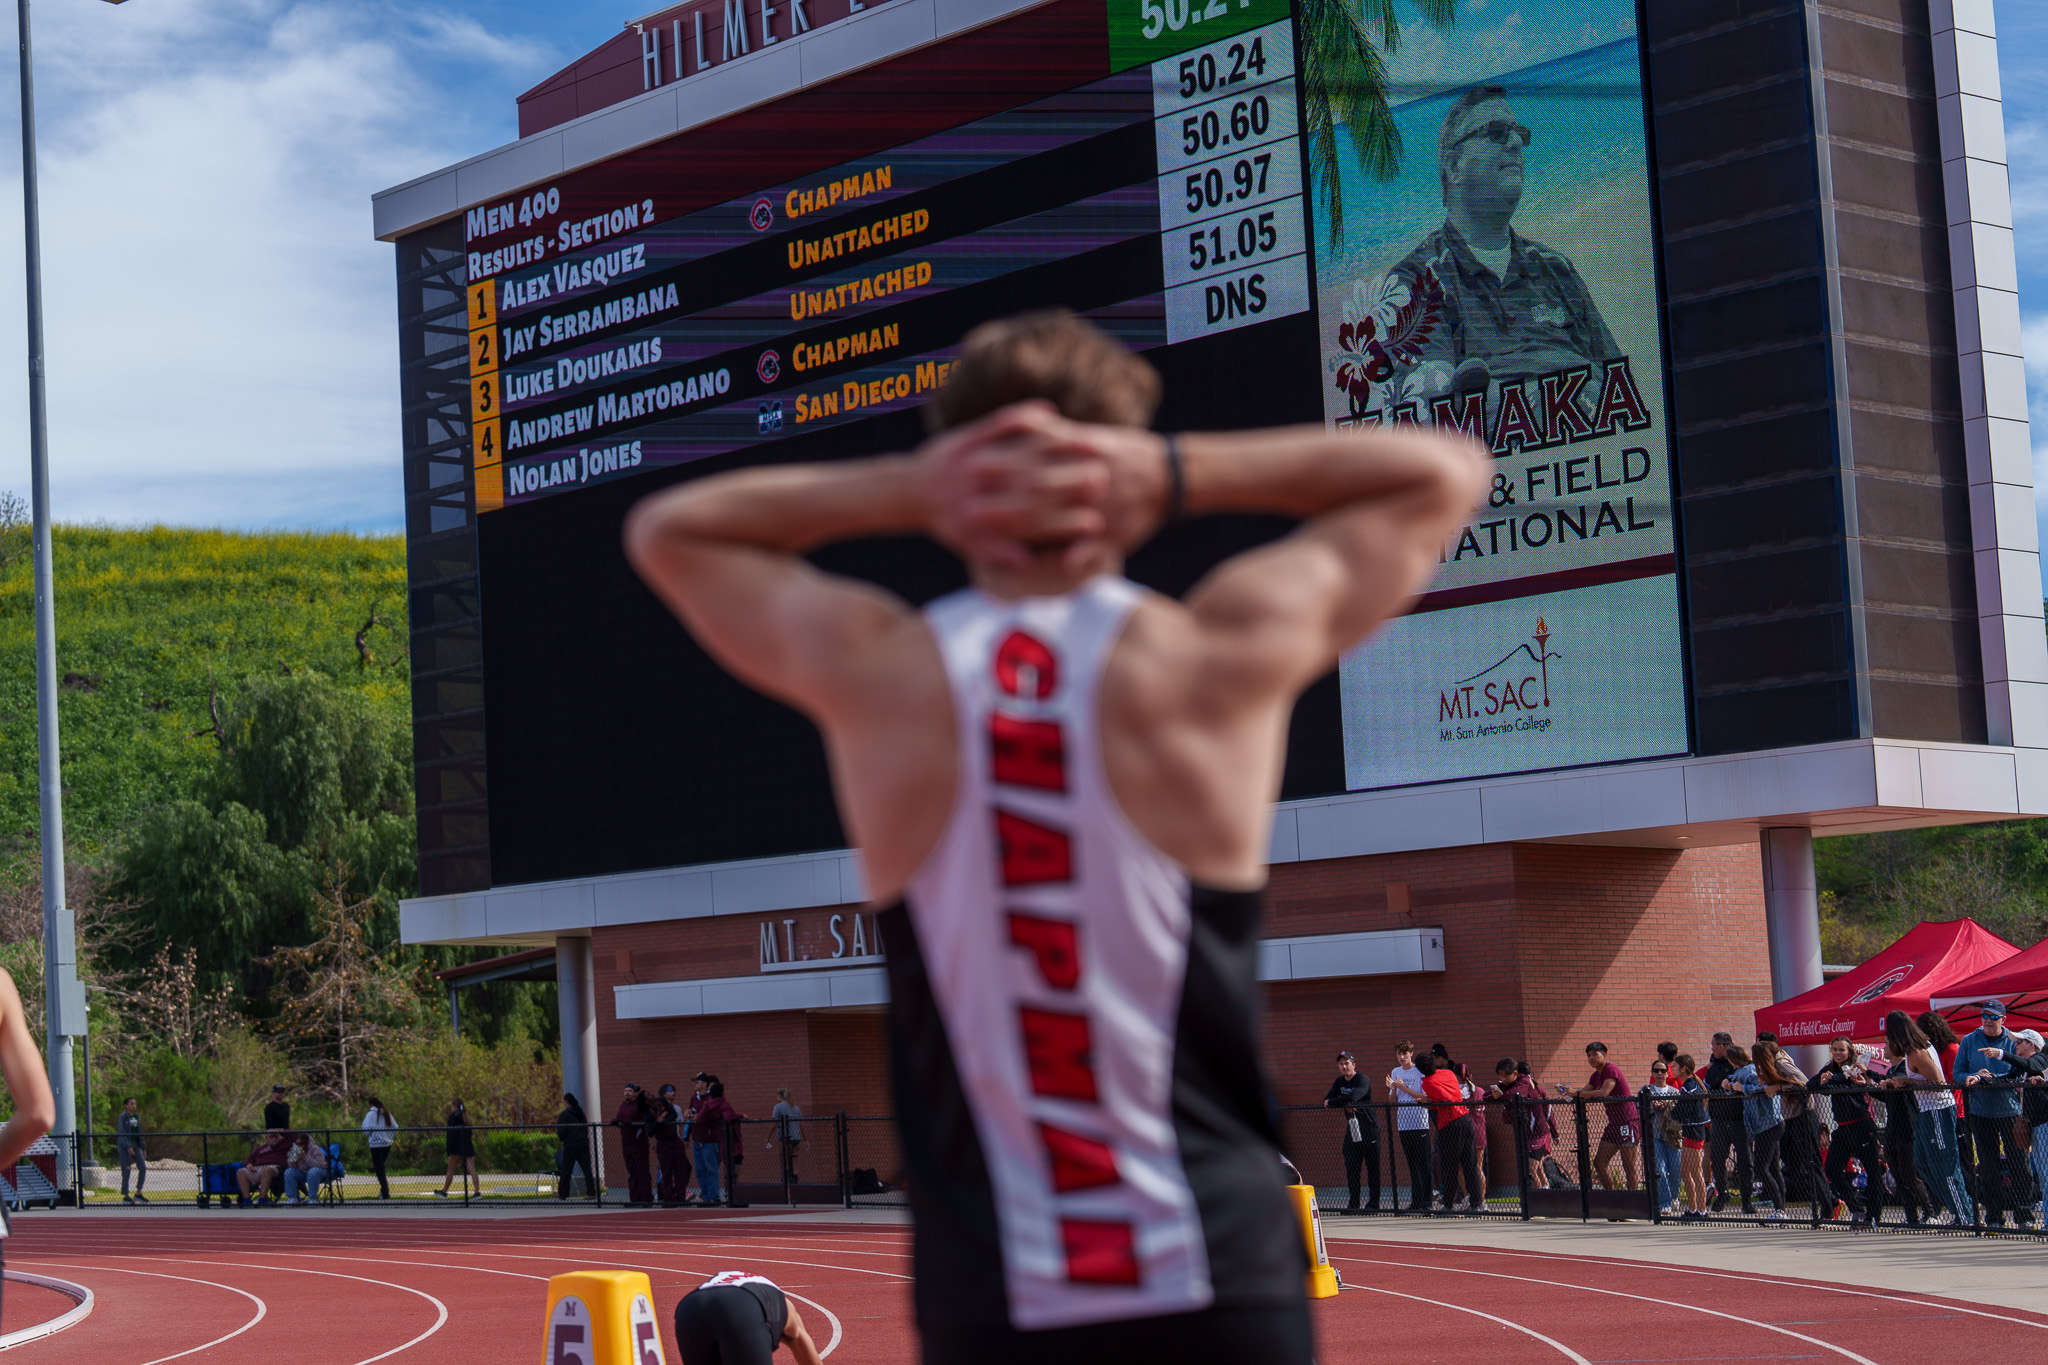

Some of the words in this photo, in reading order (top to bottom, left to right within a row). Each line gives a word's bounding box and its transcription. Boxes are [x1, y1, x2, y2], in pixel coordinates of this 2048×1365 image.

[642, 0, 810, 91] HILMER
[1141, 0, 1249, 40] 50.
[1179, 36, 1266, 98] 50.24
[1183, 95, 1269, 156] 50.60
[785, 165, 892, 218] CHAPMAN
[1186, 153, 1272, 213] 50.97
[467, 202, 514, 243] MEN
[519, 187, 560, 227] 400
[468, 235, 545, 281] RESULTS
[558, 203, 638, 252] SECTION
[642, 199, 655, 224] 2
[788, 208, 930, 270] UNATTACHED
[1189, 210, 1277, 271] 51.05
[477, 288, 487, 320] 1
[502, 273, 551, 311] ALEX
[553, 243, 646, 294] VASQUEZ
[790, 261, 932, 321] UNATTACHED
[1205, 273, 1267, 325] DNS
[478, 334, 490, 366] 2
[502, 325, 536, 361] JAY
[539, 282, 680, 347] SERRAMBANA
[792, 323, 899, 371] CHAPMAN
[479, 380, 491, 412] 3
[506, 368, 554, 403] LUKE
[557, 337, 662, 389] DOUKAKIS
[795, 391, 838, 423] SAN
[843, 373, 911, 411] DIEGO
[915, 359, 962, 394] MES
[507, 405, 594, 450] ANDREW
[597, 368, 730, 426] MARTORANO
[1335, 355, 1651, 459] MAKA
[481, 426, 493, 458] 4
[509, 457, 576, 496] NOLAN
[579, 440, 642, 483] JONES
[1526, 447, 1651, 502] FIELD
[1439, 686, 1479, 722] MT.
[1484, 676, 1538, 716] SAC
[1440, 727, 1455, 742] Mt.
[1456, 726, 1474, 740] San
[1476, 720, 1513, 738] Antonio
[1515, 714, 1552, 733] College
[989, 628, 1142, 1287] CHAPMAN
[1779, 1023, 1793, 1038] Track
[1794, 1022, 1800, 1036] &
[1831, 1018, 1857, 1036] Country
